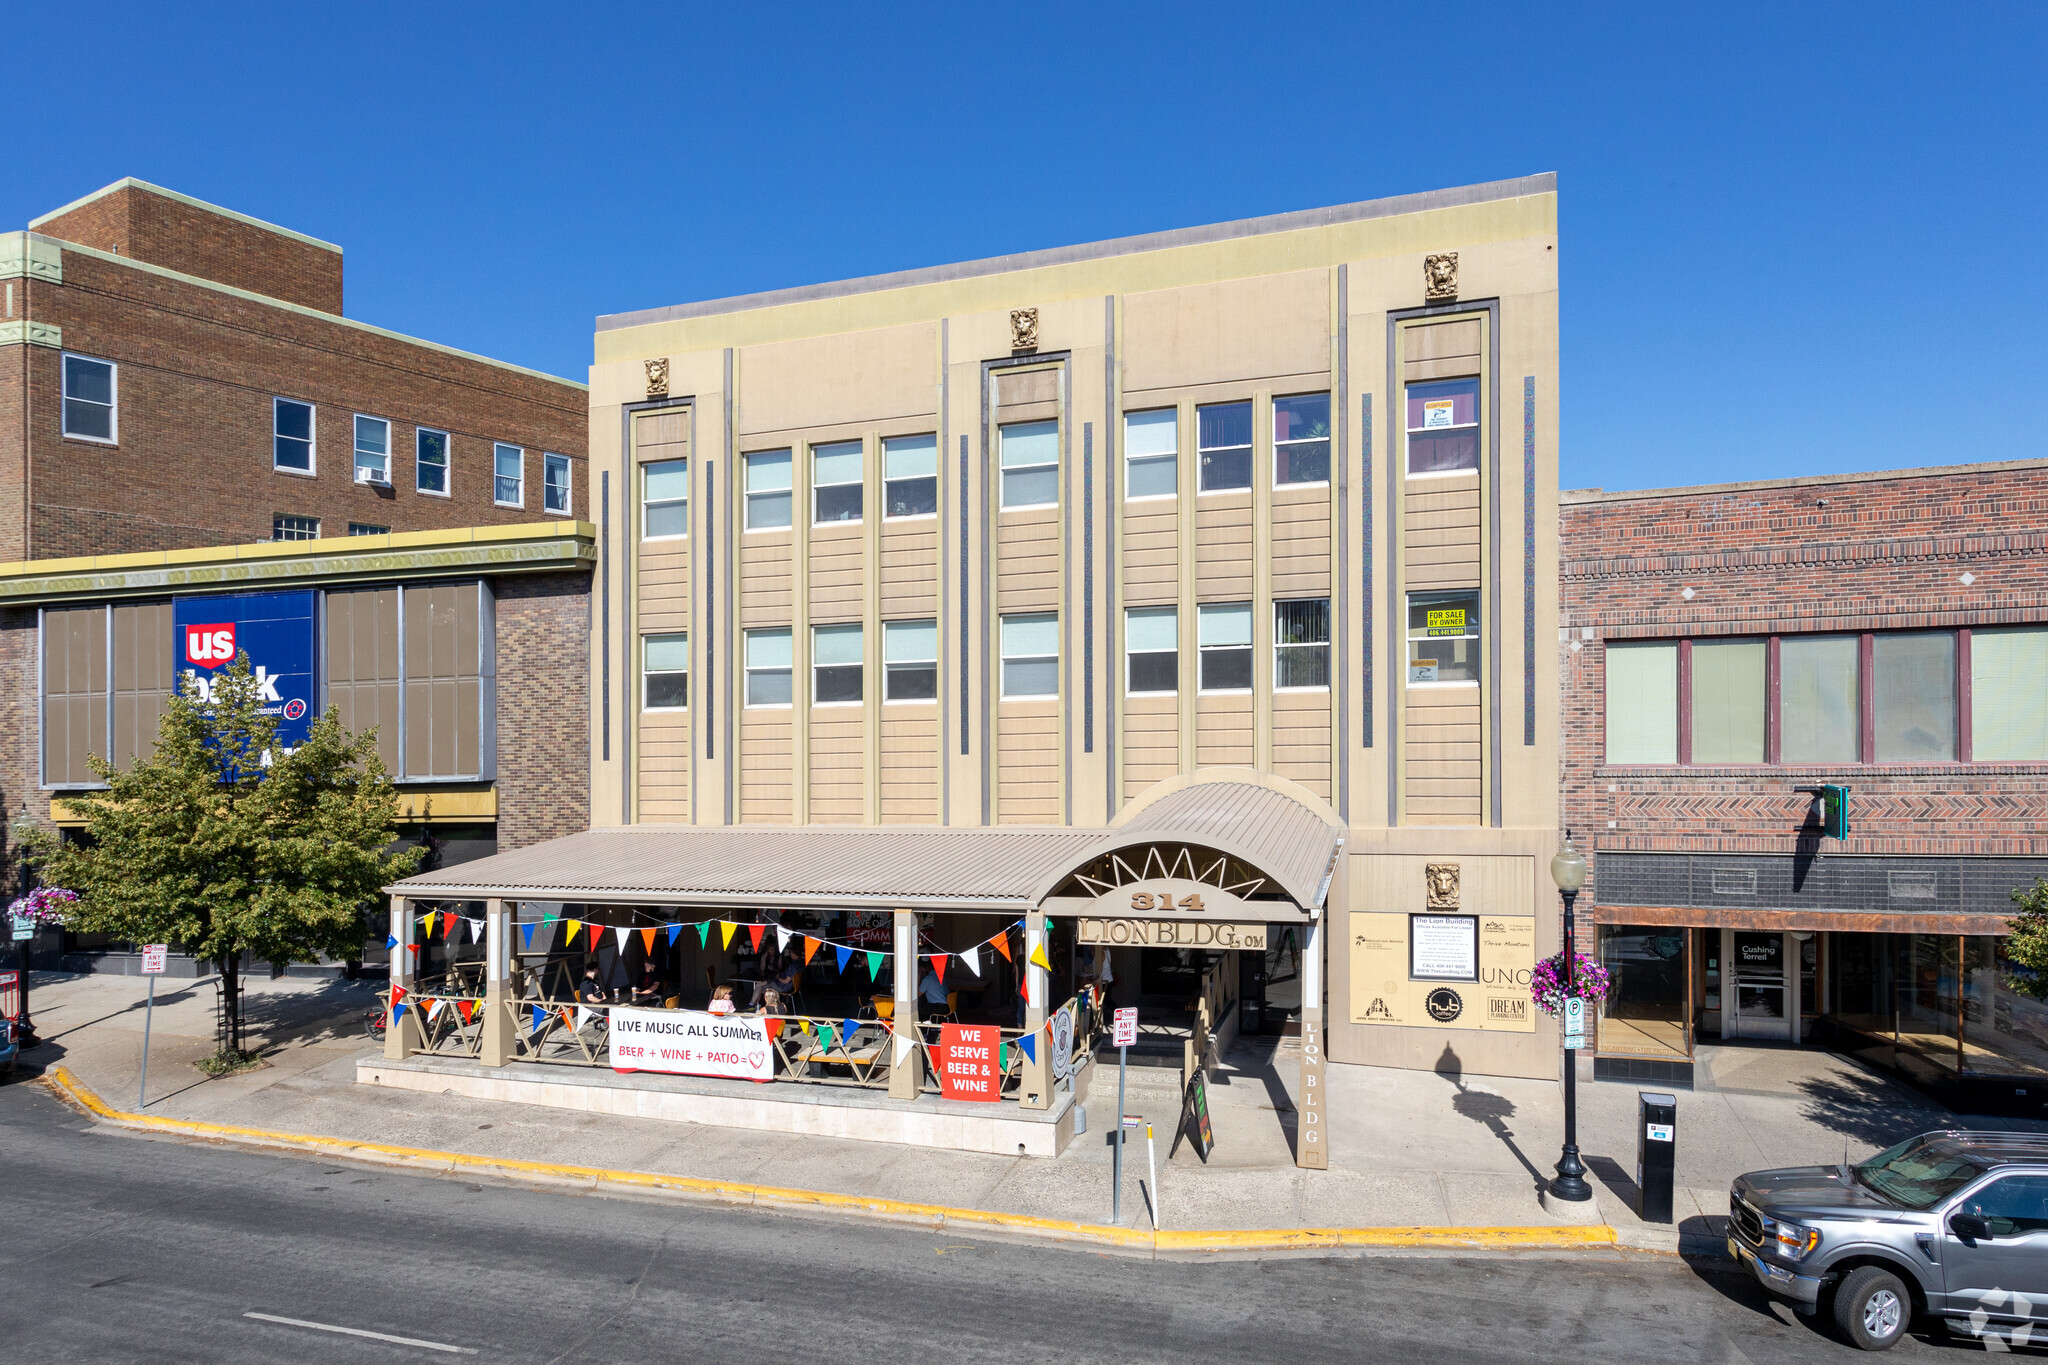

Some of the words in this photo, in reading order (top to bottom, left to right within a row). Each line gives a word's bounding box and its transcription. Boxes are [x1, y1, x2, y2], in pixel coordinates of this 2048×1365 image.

[1446, 610, 1463, 618] SALE
[189, 631, 233, 660] us
[185, 666, 281, 704] bak
[1131, 892, 1205, 911] 314
[850, 918, 869, 926] LOVE
[1446, 918, 1473, 926] Building
[1079, 918, 1150, 944] LION
[1742, 945, 1776, 956] Cushing
[1742, 952, 1767, 960] Terrell
[1482, 968, 1532, 985] UNO
[1429, 998, 1460, 1011] hub
[1490, 999, 1525, 1014] DREAM
[617, 1020, 641, 1032] LIVE
[645, 1022, 684, 1036] MUSIC
[687, 1025, 708, 1037] ALL
[712, 1026, 762, 1042] SUMMER
[960, 1030, 980, 1042] WE
[1304, 1023, 1319, 1065] LION
[619, 1046, 644, 1057] BEER
[661, 1049, 691, 1060] WINE
[950, 1046, 988, 1059] SERVE
[948, 1062, 977, 1076] BEER
[981, 1064, 990, 1076] &
[952, 1078, 988, 1092] WINE
[1305, 1074, 1318, 1143] BLDG
